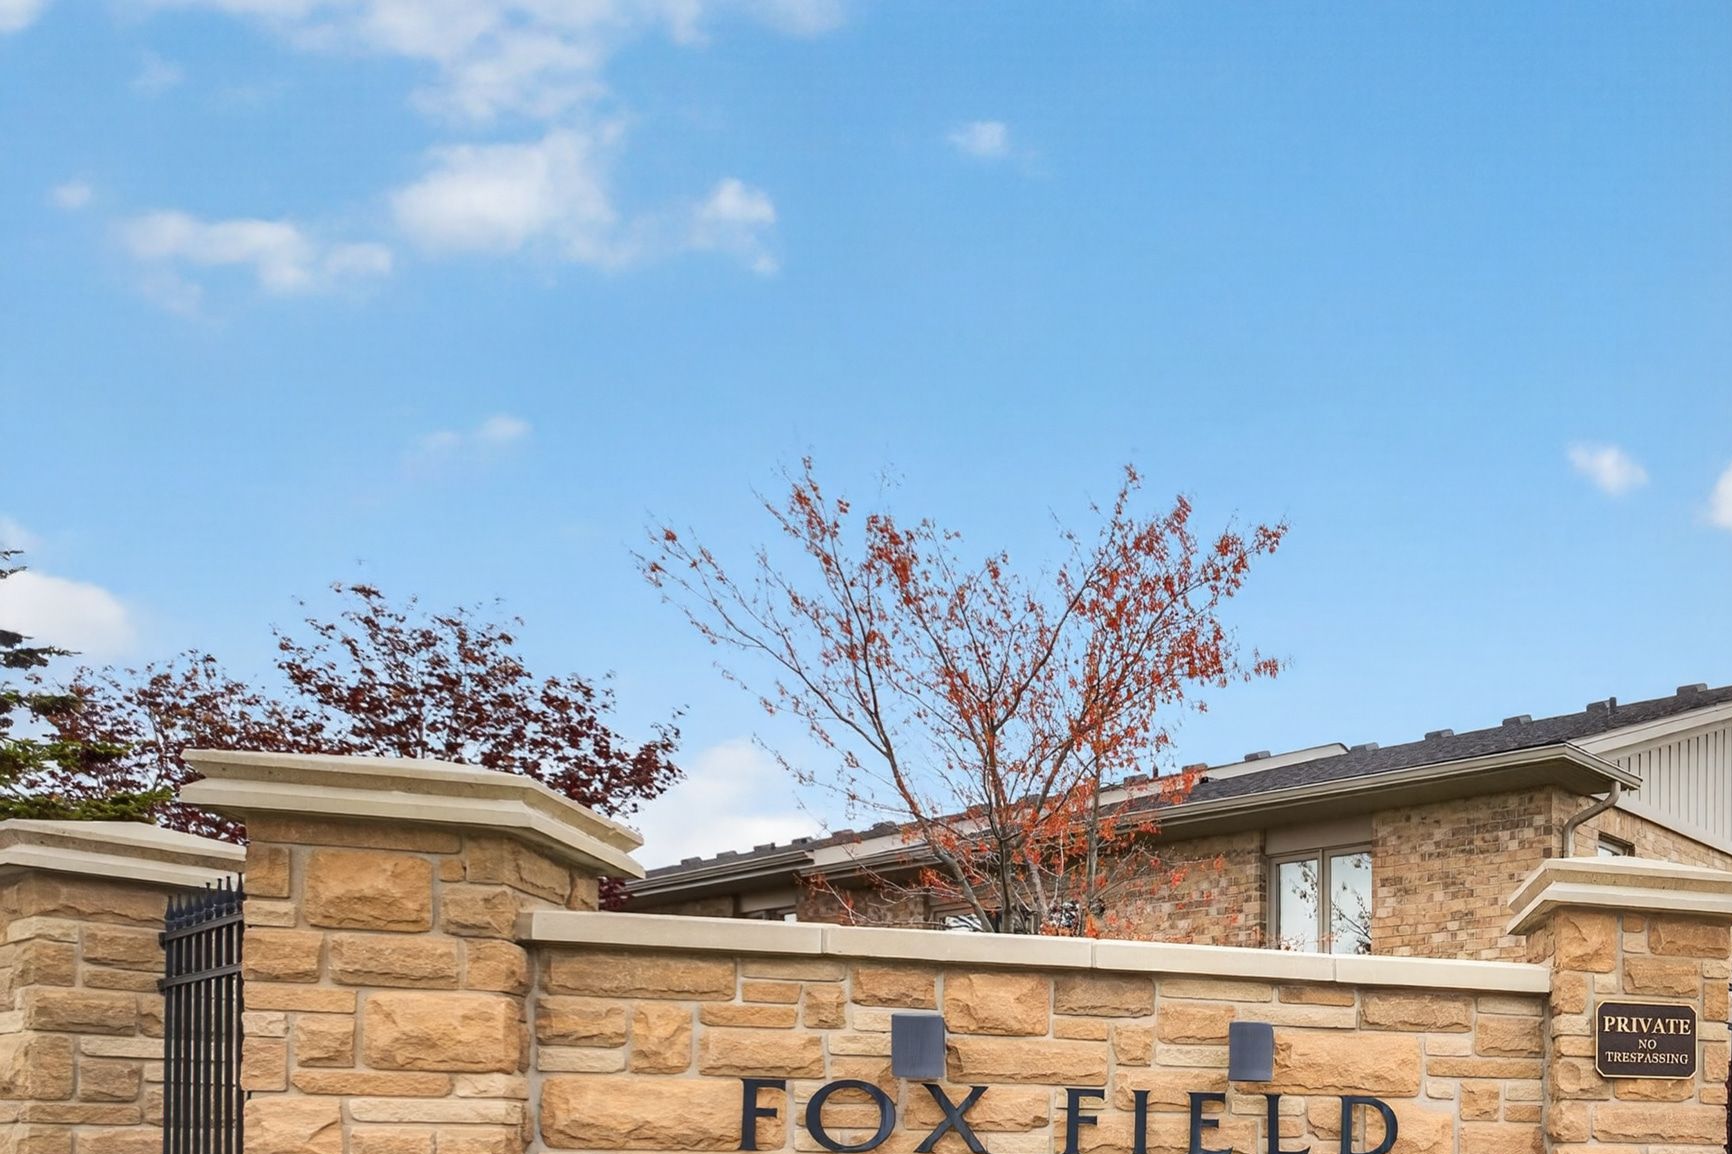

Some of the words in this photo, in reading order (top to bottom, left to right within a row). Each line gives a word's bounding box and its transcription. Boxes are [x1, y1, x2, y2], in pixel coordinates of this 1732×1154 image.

[1602, 1015, 1692, 1035] PRIVATE
[1638, 1039, 1657, 1050] NO
[1605, 1051, 1689, 1065] TRESPASSING
[737, 1077, 989, 1154] FOX
